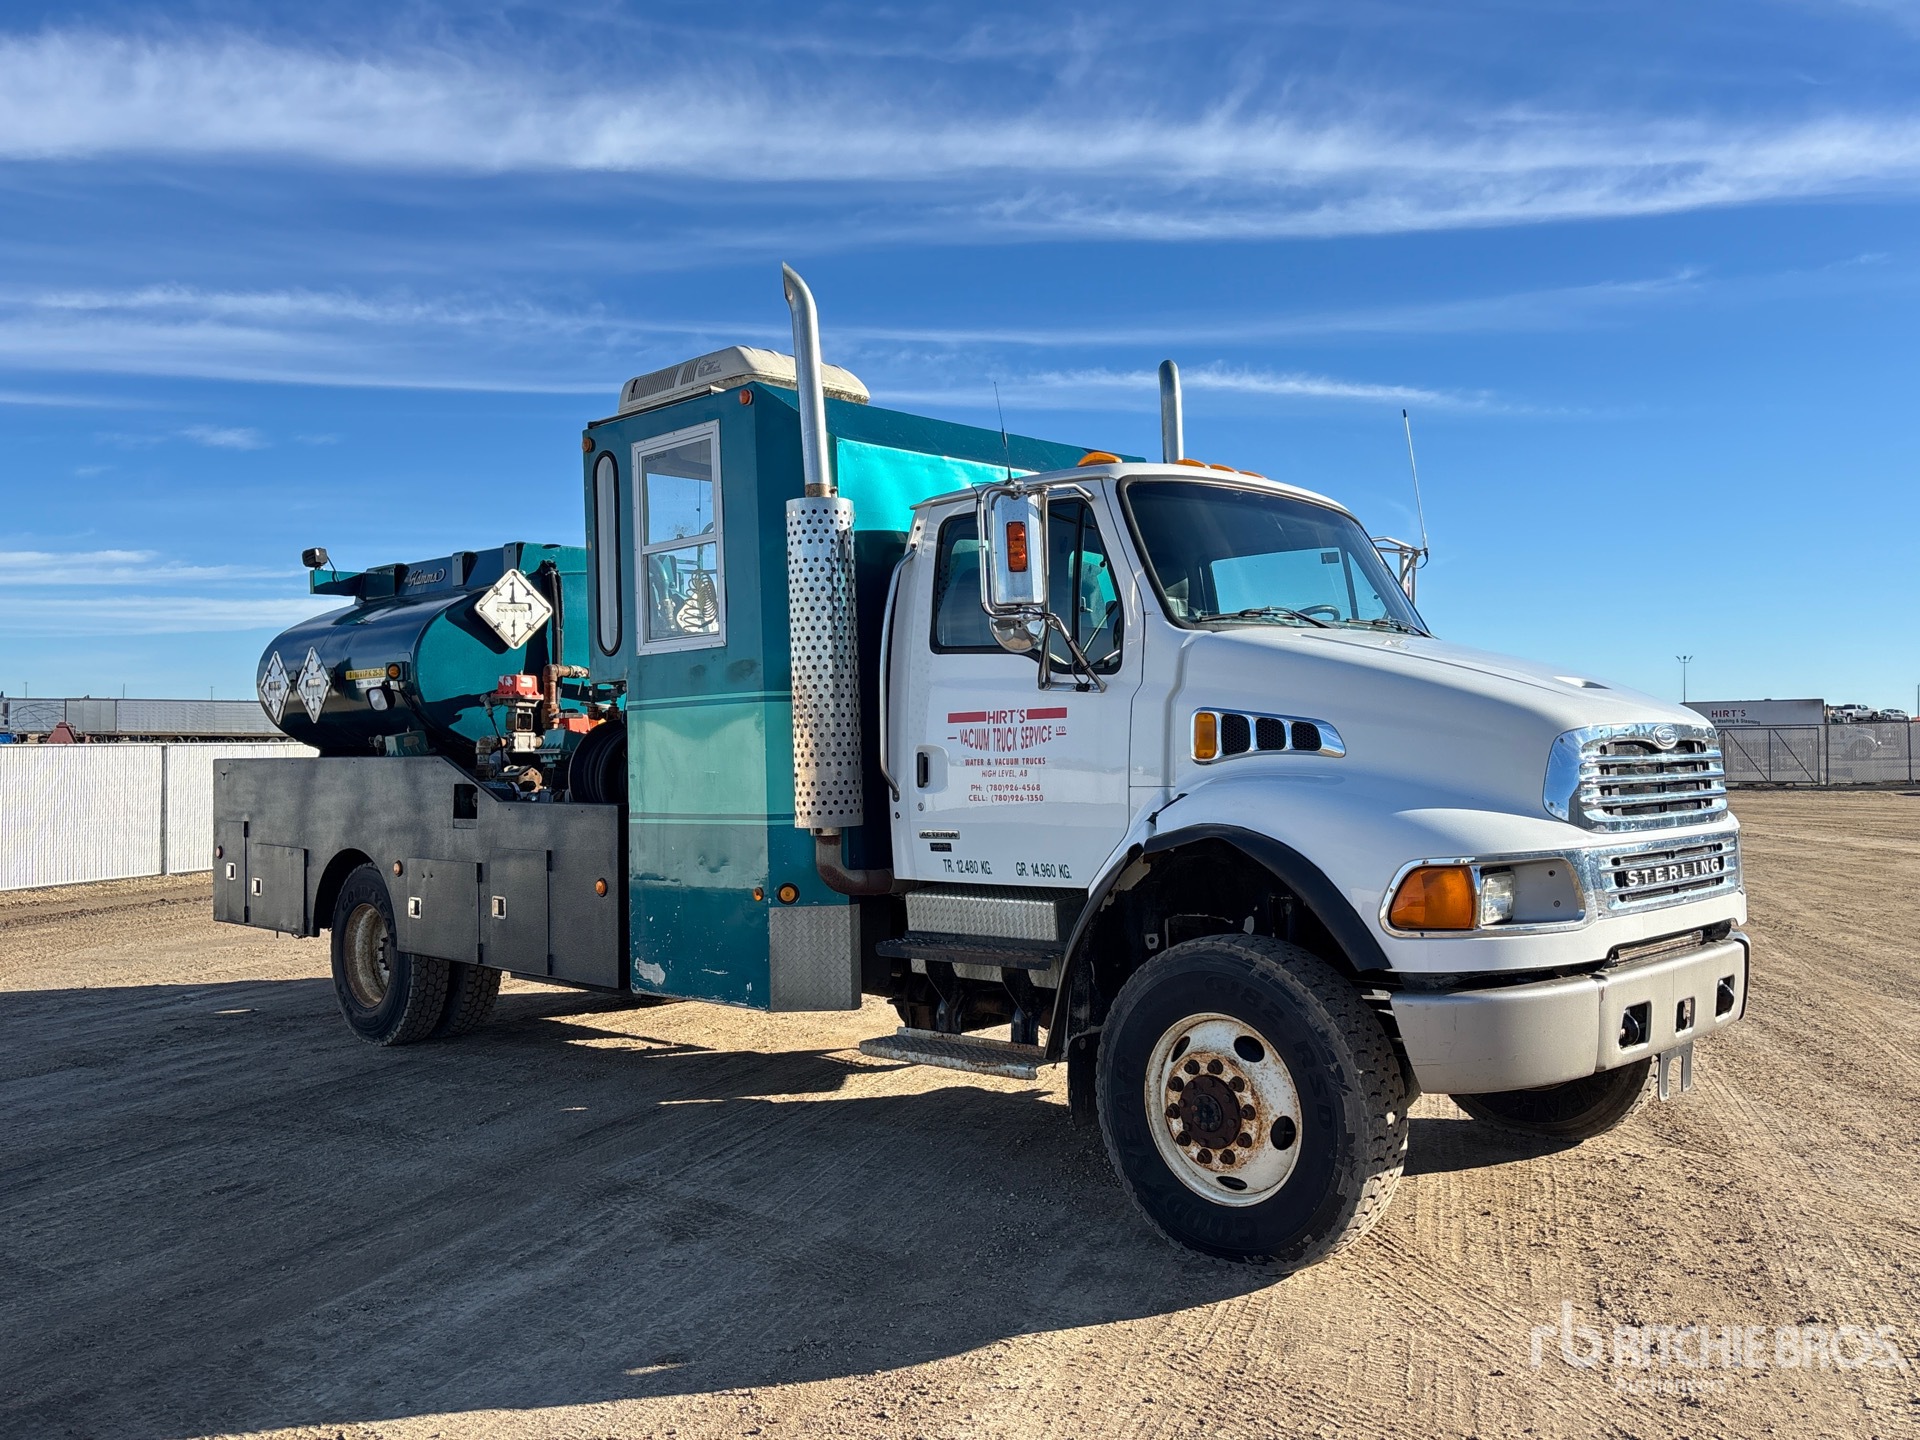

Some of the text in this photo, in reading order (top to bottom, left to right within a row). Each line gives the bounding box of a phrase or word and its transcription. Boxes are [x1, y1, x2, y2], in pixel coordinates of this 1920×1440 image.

[987, 709, 1026, 724] HIRT'S
[1711, 709, 1746, 718] HIRT'S
[959, 728, 990, 751] VACUUM
[993, 727, 1018, 752] TRUCK
[1020, 725, 1052, 749] SERVICE
[965, 757, 1046, 766] WATER & VACUUM TRUCKS
[981, 769, 1028, 778] HIGH LEVEL, AB
[986, 784, 1041, 792] (780)926-4568
[968, 794, 1044, 803] CELL: (780)926-1350
[942, 859, 954, 873] TR.
[980, 860, 993, 875] KG.
[1015, 861, 1029, 876] GR.
[1031, 862, 1057, 878] 14.960
[1058, 864, 1072, 879] KG.
[1625, 858, 1720, 887] STERLING
